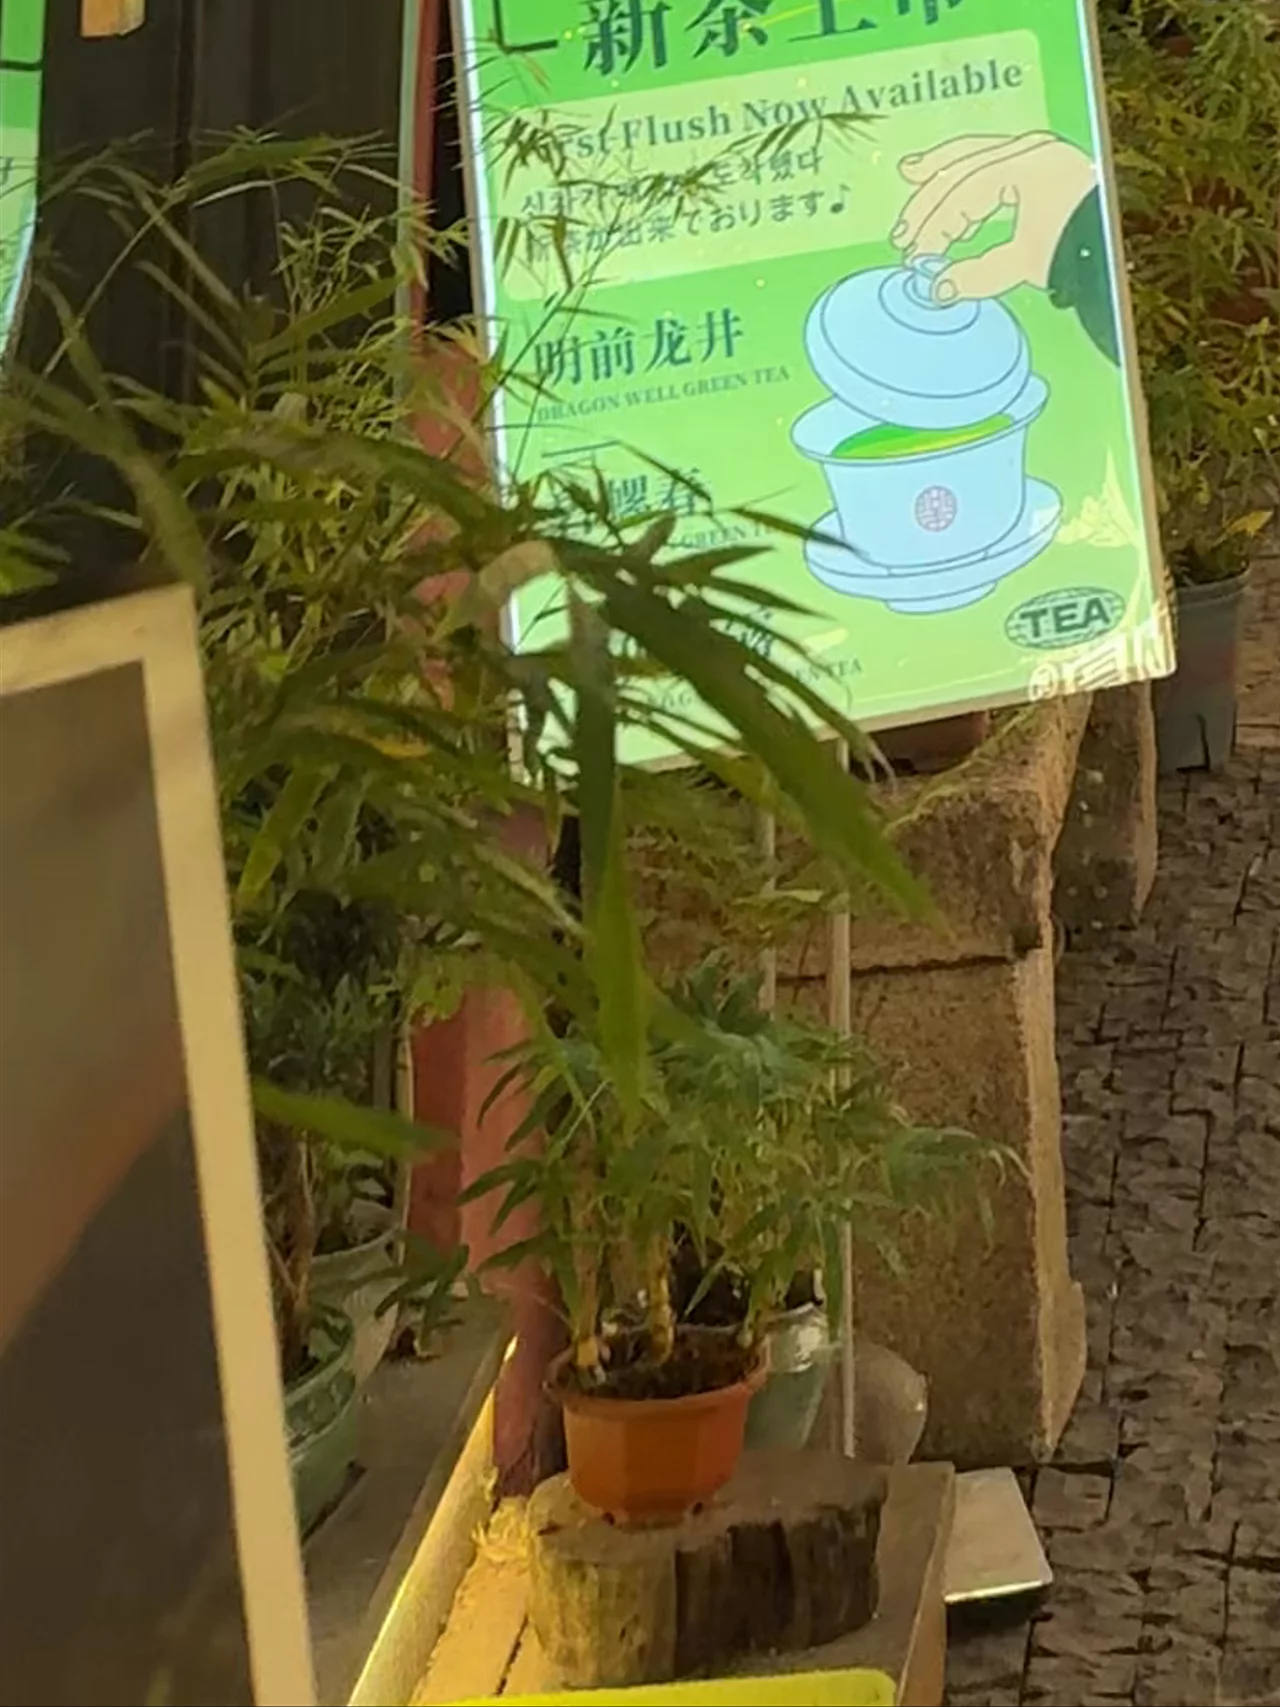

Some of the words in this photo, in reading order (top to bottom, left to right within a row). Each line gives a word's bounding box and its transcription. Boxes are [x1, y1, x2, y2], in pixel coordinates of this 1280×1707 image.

[623, 104, 731, 150] Flush
[743, 95, 837, 131] Now
[842, 58, 1024, 113] Available
[534, 307, 744, 386] 明前龙井
[536, 396, 620, 422] DRAGON
[624, 384, 681, 407] WELL
[682, 370, 748, 397] GREEN
[752, 365, 790, 385] TEA
[1018, 595, 1112, 640] TEA
